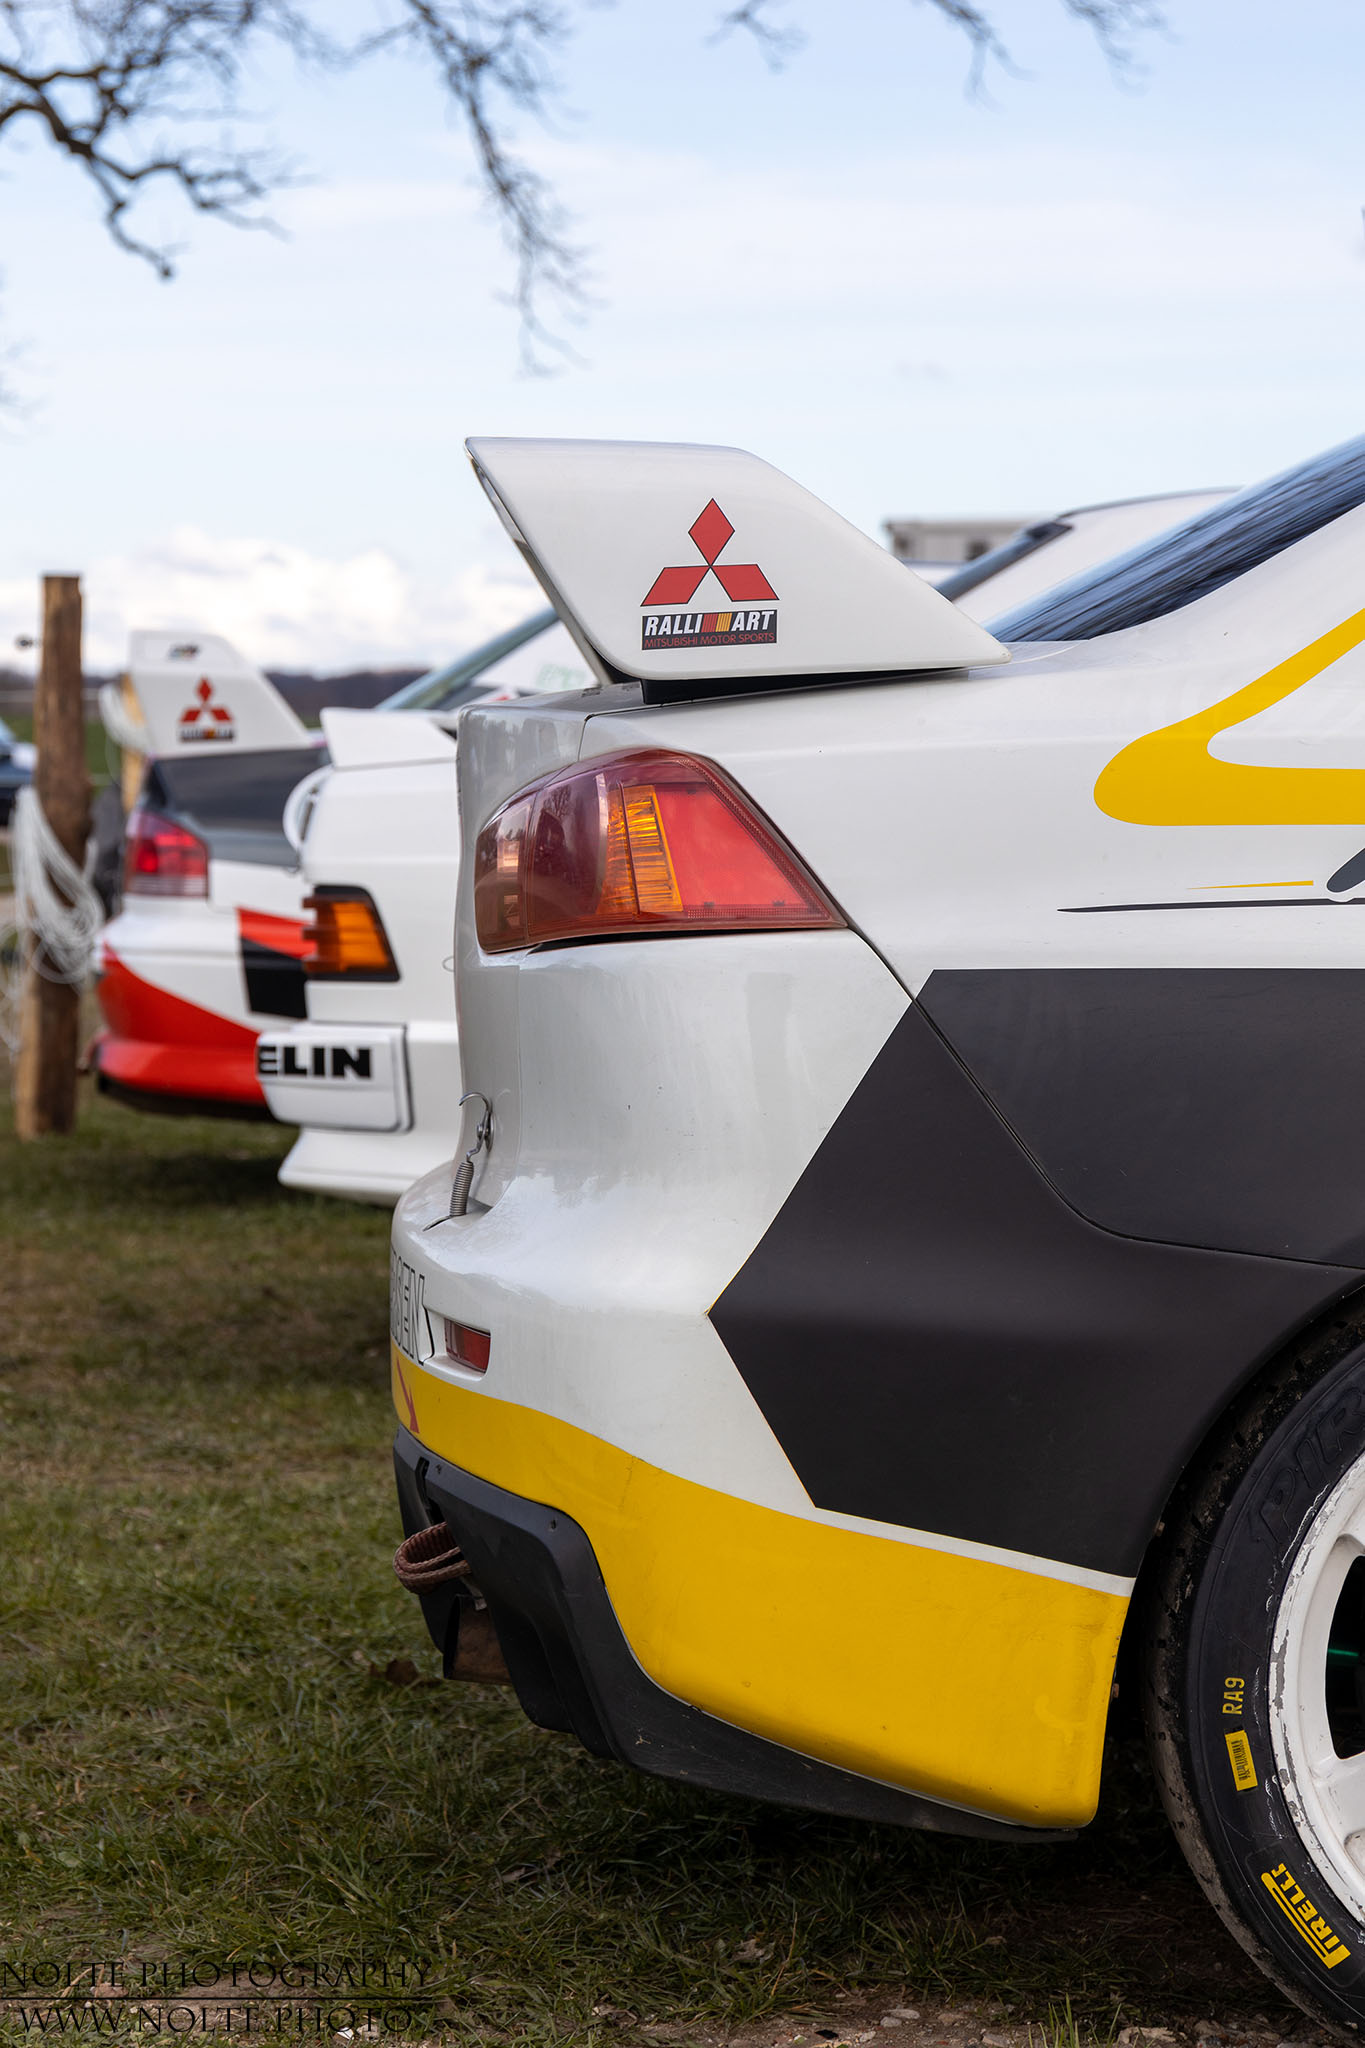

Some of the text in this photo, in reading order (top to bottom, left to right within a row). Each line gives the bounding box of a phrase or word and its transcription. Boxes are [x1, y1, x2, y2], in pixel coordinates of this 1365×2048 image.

[644, 611, 774, 636] RALLI ART
[645, 633, 775, 648] MITSUBISHI MOTOR SPORTS
[258, 1045, 371, 1078] ELIN
[1221, 1677, 1245, 1715] RA9
